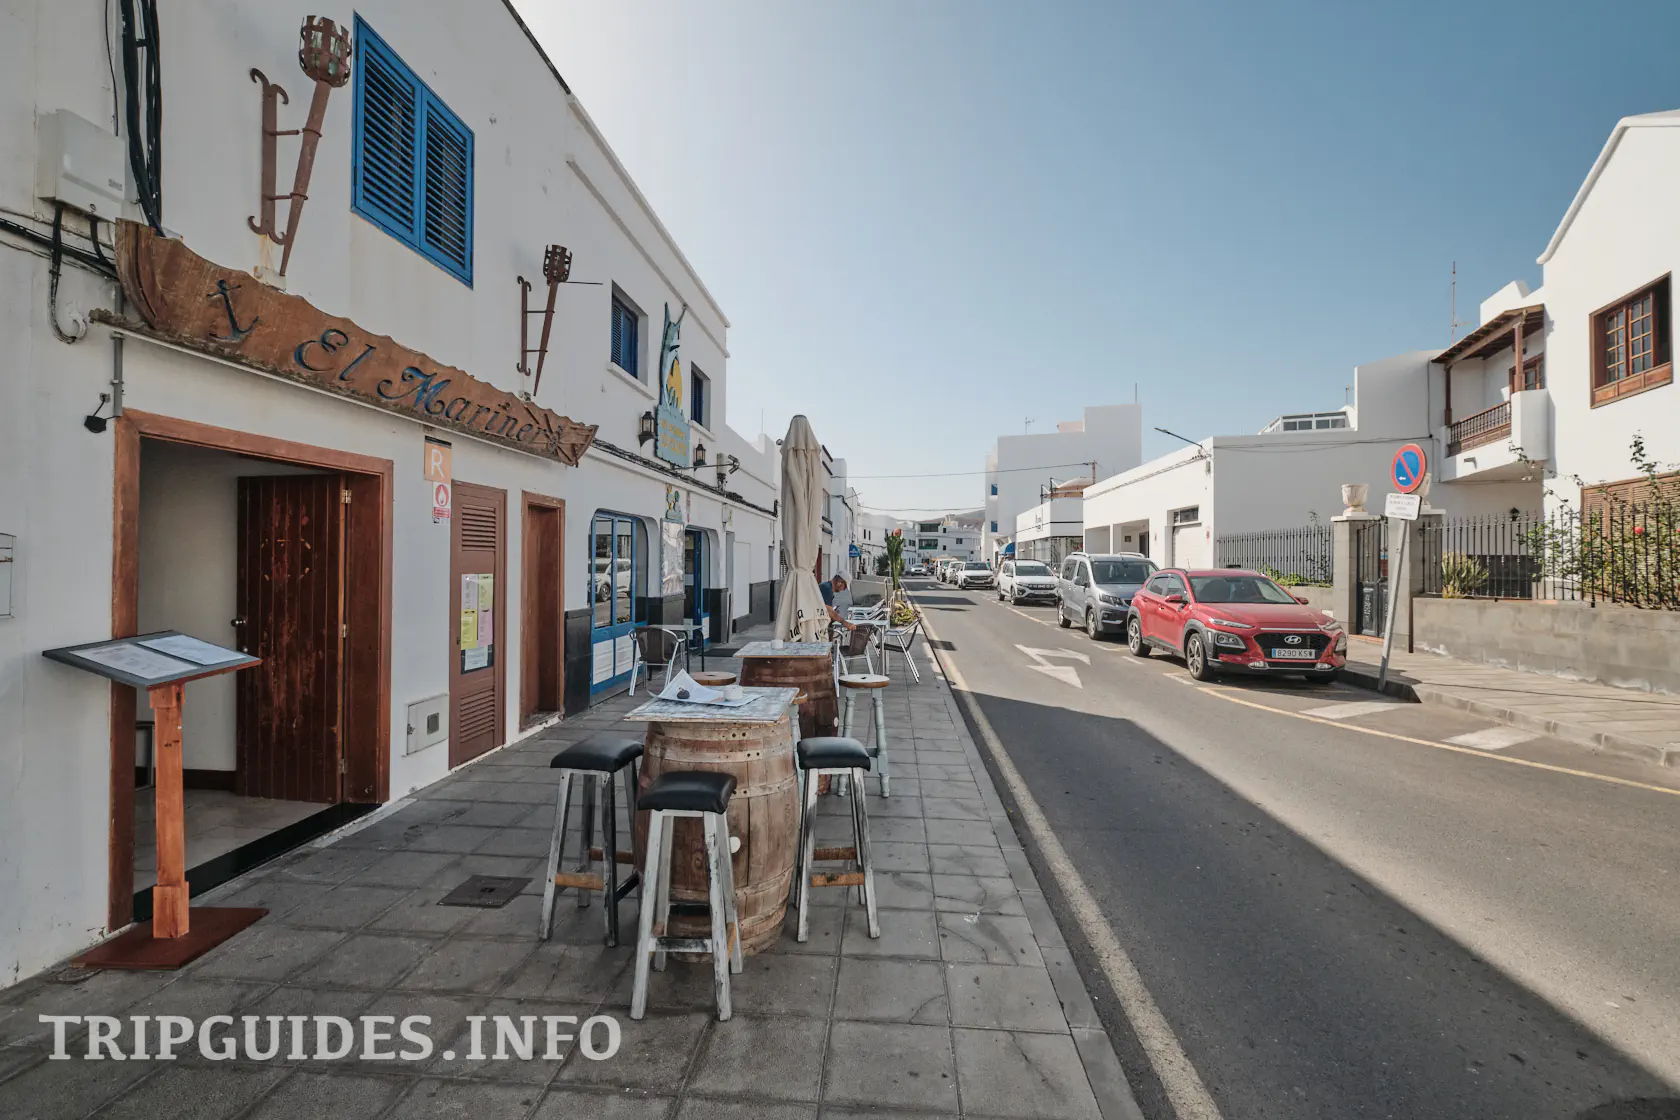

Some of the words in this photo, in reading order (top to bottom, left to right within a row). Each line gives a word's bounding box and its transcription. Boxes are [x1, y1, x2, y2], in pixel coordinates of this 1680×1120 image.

[293, 328, 377, 382] El
[431, 448, 445, 478] R
[1277, 649, 1297, 657] 8290
